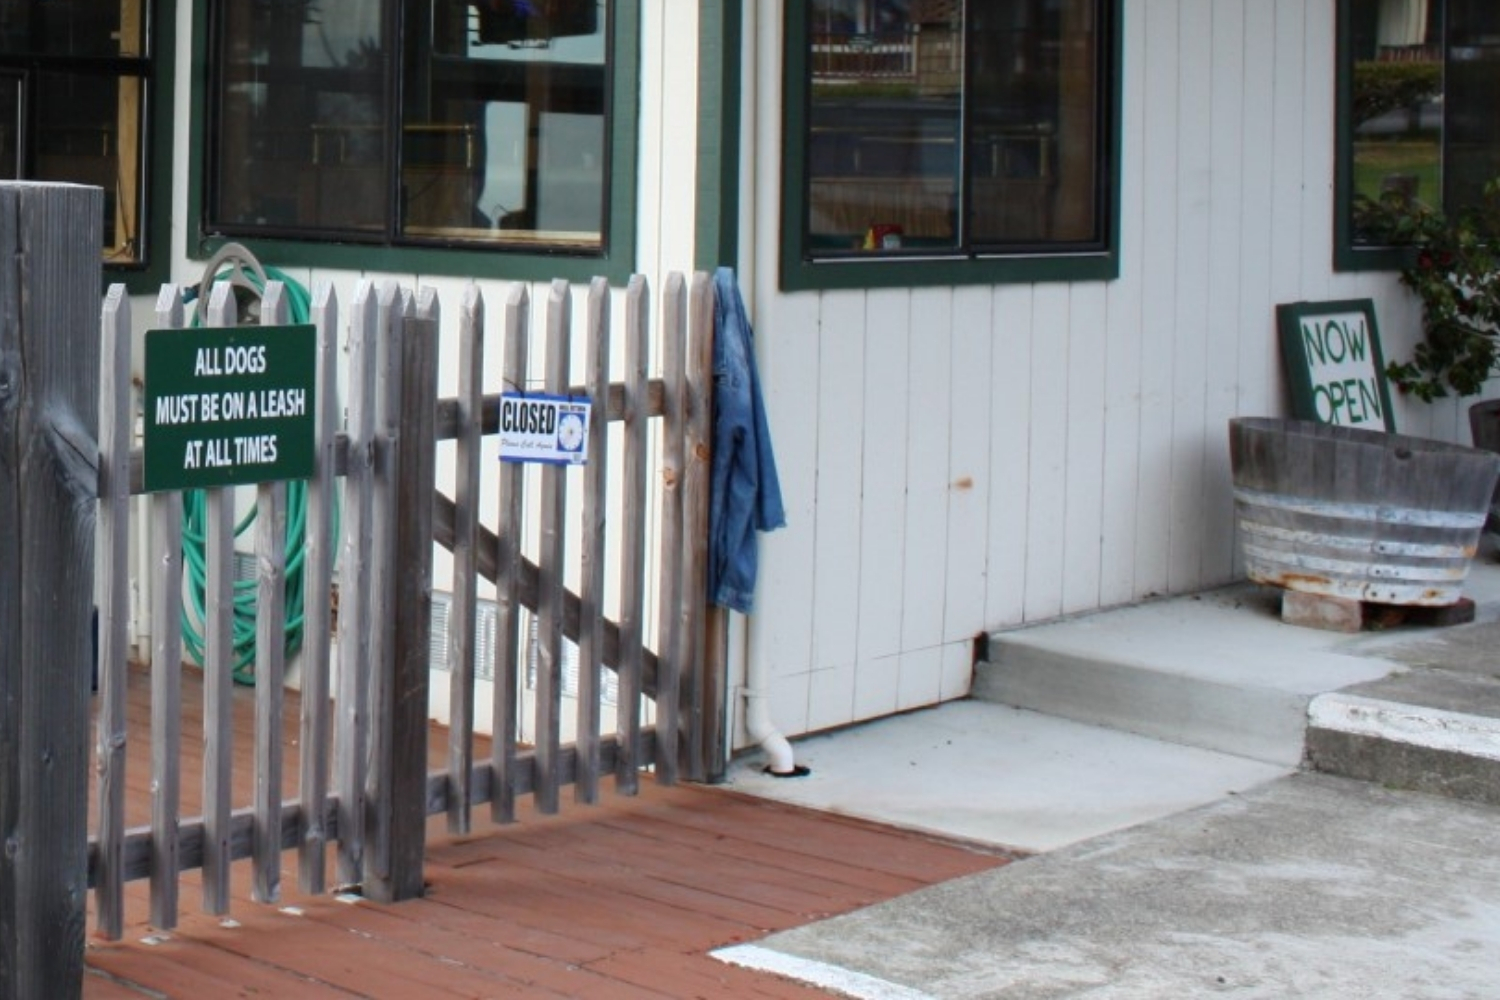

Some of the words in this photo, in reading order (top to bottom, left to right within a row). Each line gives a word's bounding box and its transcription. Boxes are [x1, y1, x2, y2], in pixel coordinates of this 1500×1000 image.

[194, 347, 222, 376] ALL
[225, 345, 266, 375] DOGS
[1303, 320, 1366, 366] NOW
[155, 395, 198, 425] MUST
[201, 393, 219, 422] BE
[222, 391, 244, 421] ON
[247, 391, 257, 418] A
[261, 388, 305, 417] LEASH
[502, 401, 556, 435] CLOSED
[1315, 378, 1382, 425] OPEN
[184, 440, 203, 469] AT
[205, 438, 232, 467] ALL
[234, 434, 277, 465] TIMES
